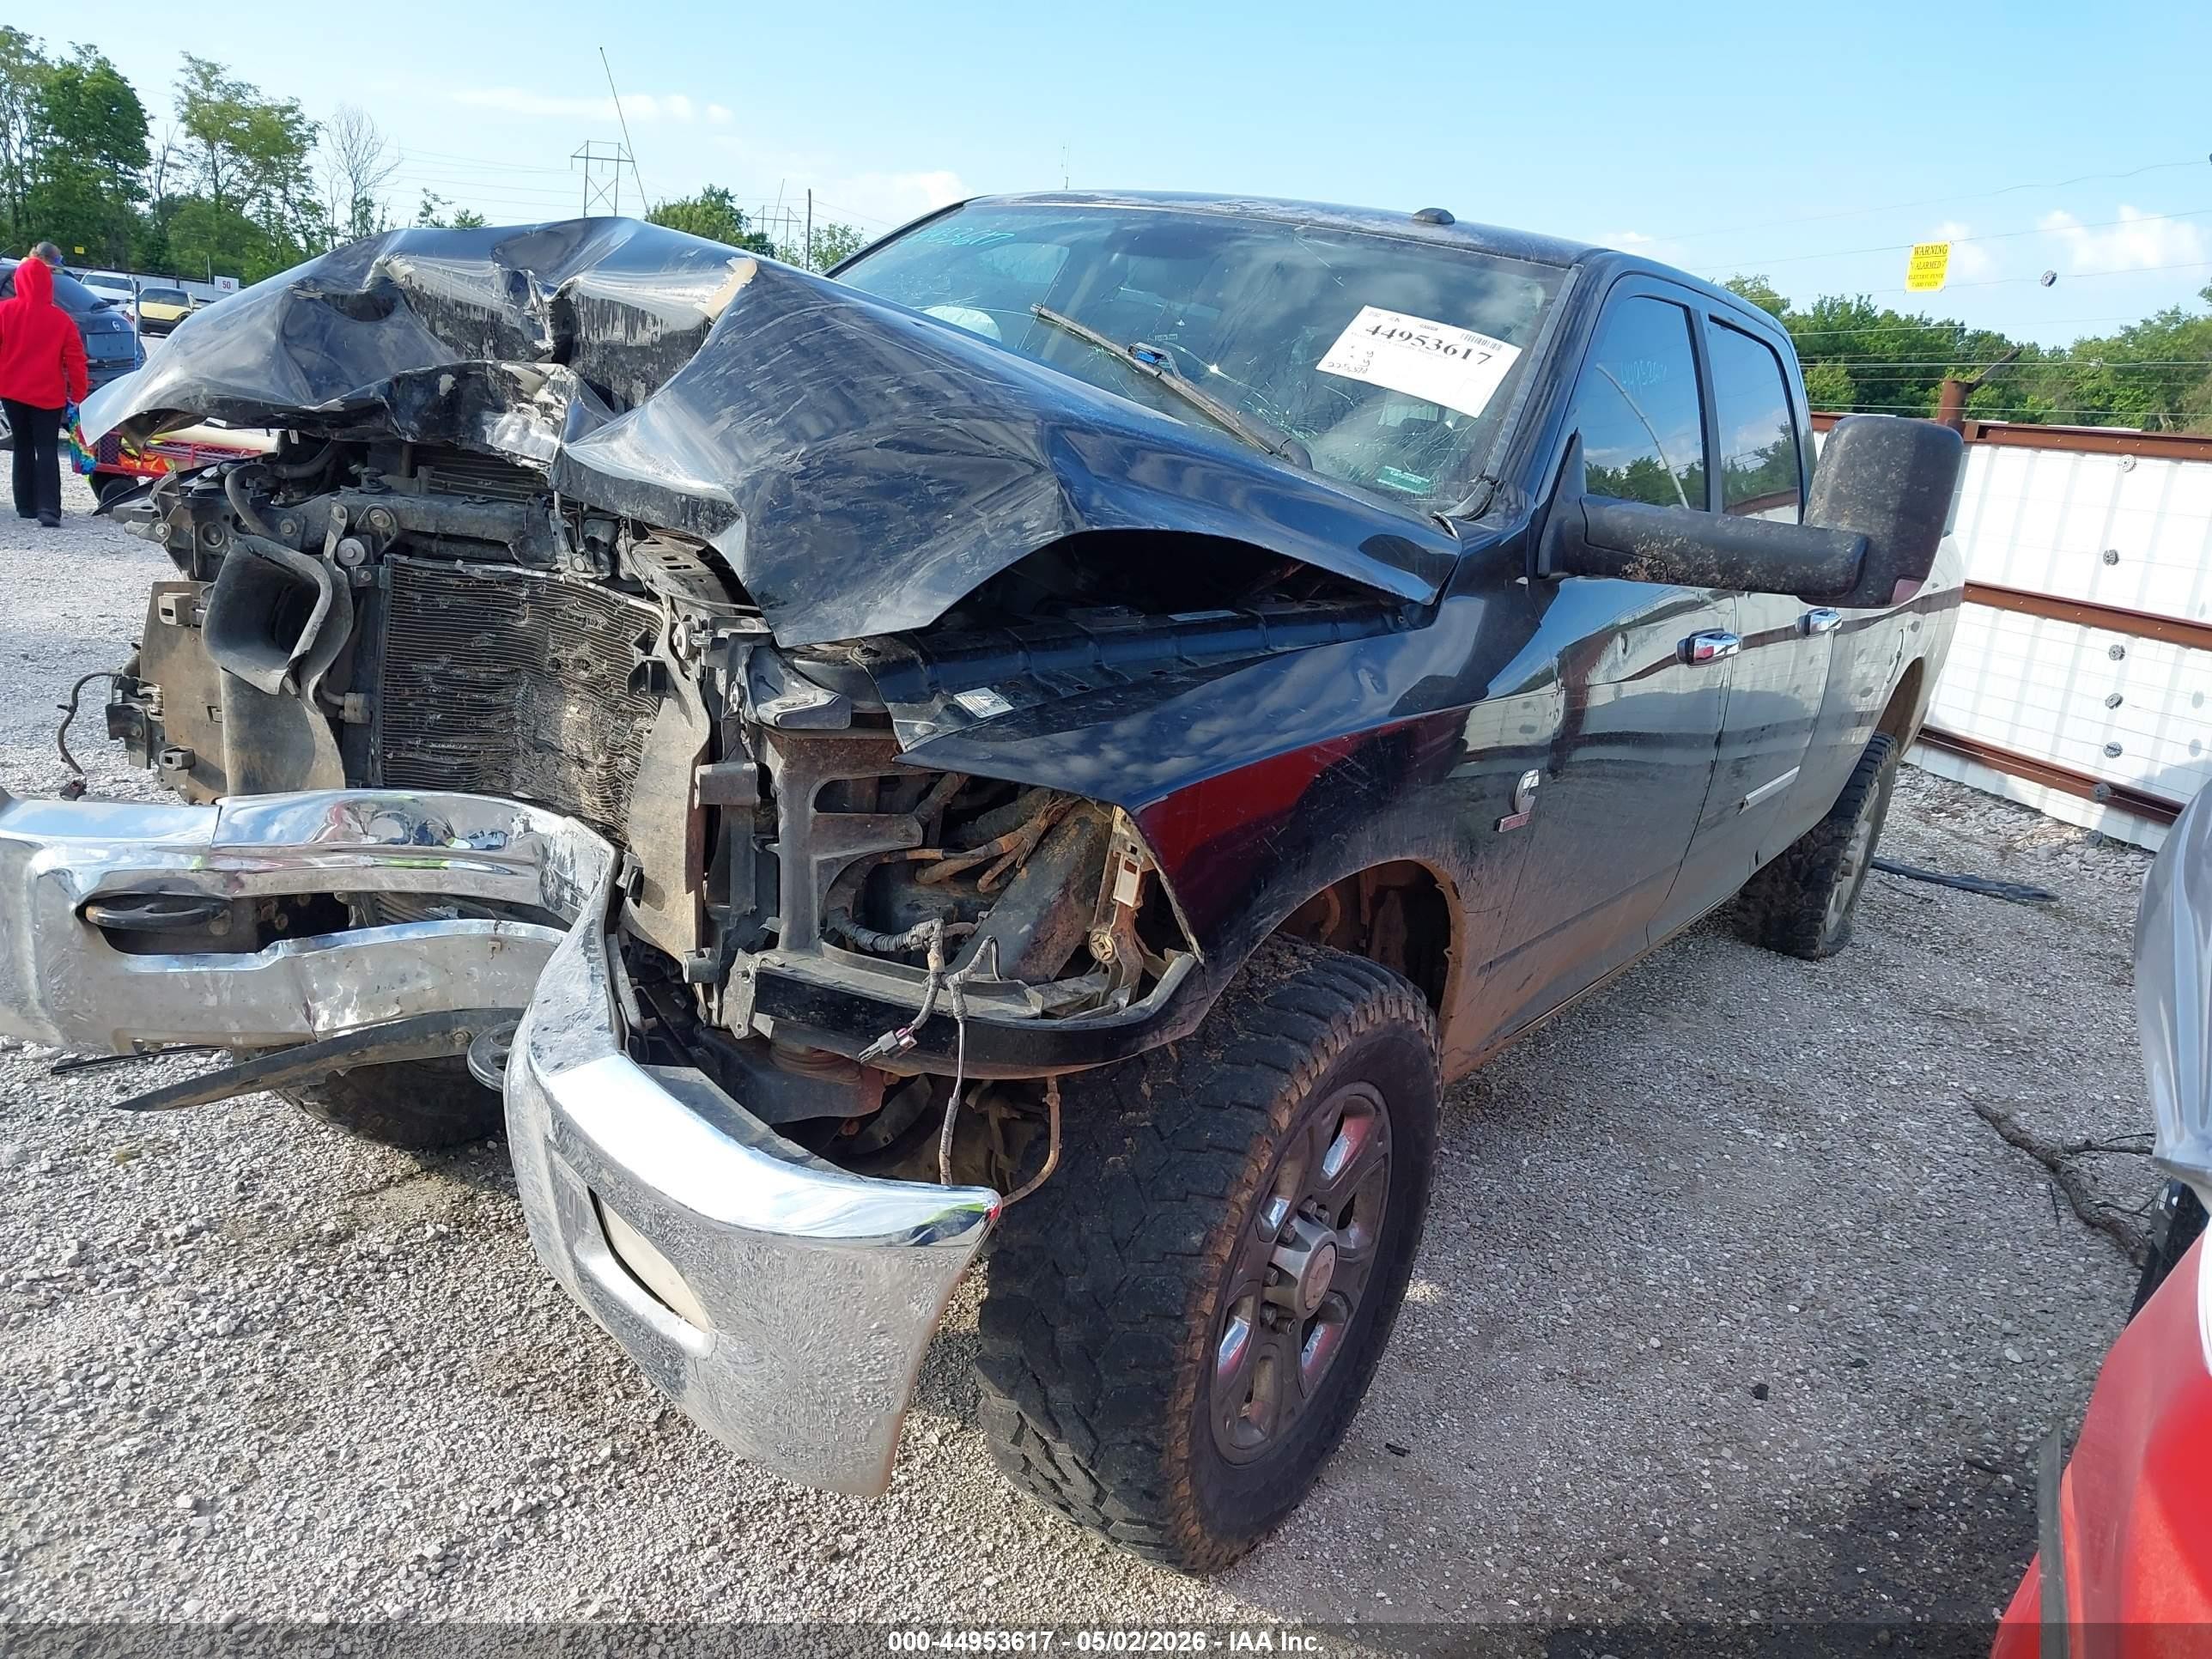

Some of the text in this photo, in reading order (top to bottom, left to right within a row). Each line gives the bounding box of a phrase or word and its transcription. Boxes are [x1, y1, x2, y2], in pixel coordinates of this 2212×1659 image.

[1914, 245, 1948, 256] WARNING
[1916, 260, 1942, 270] ALARMED
[222, 280, 231, 289] 50
[1365, 324, 1493, 365] 44953617
